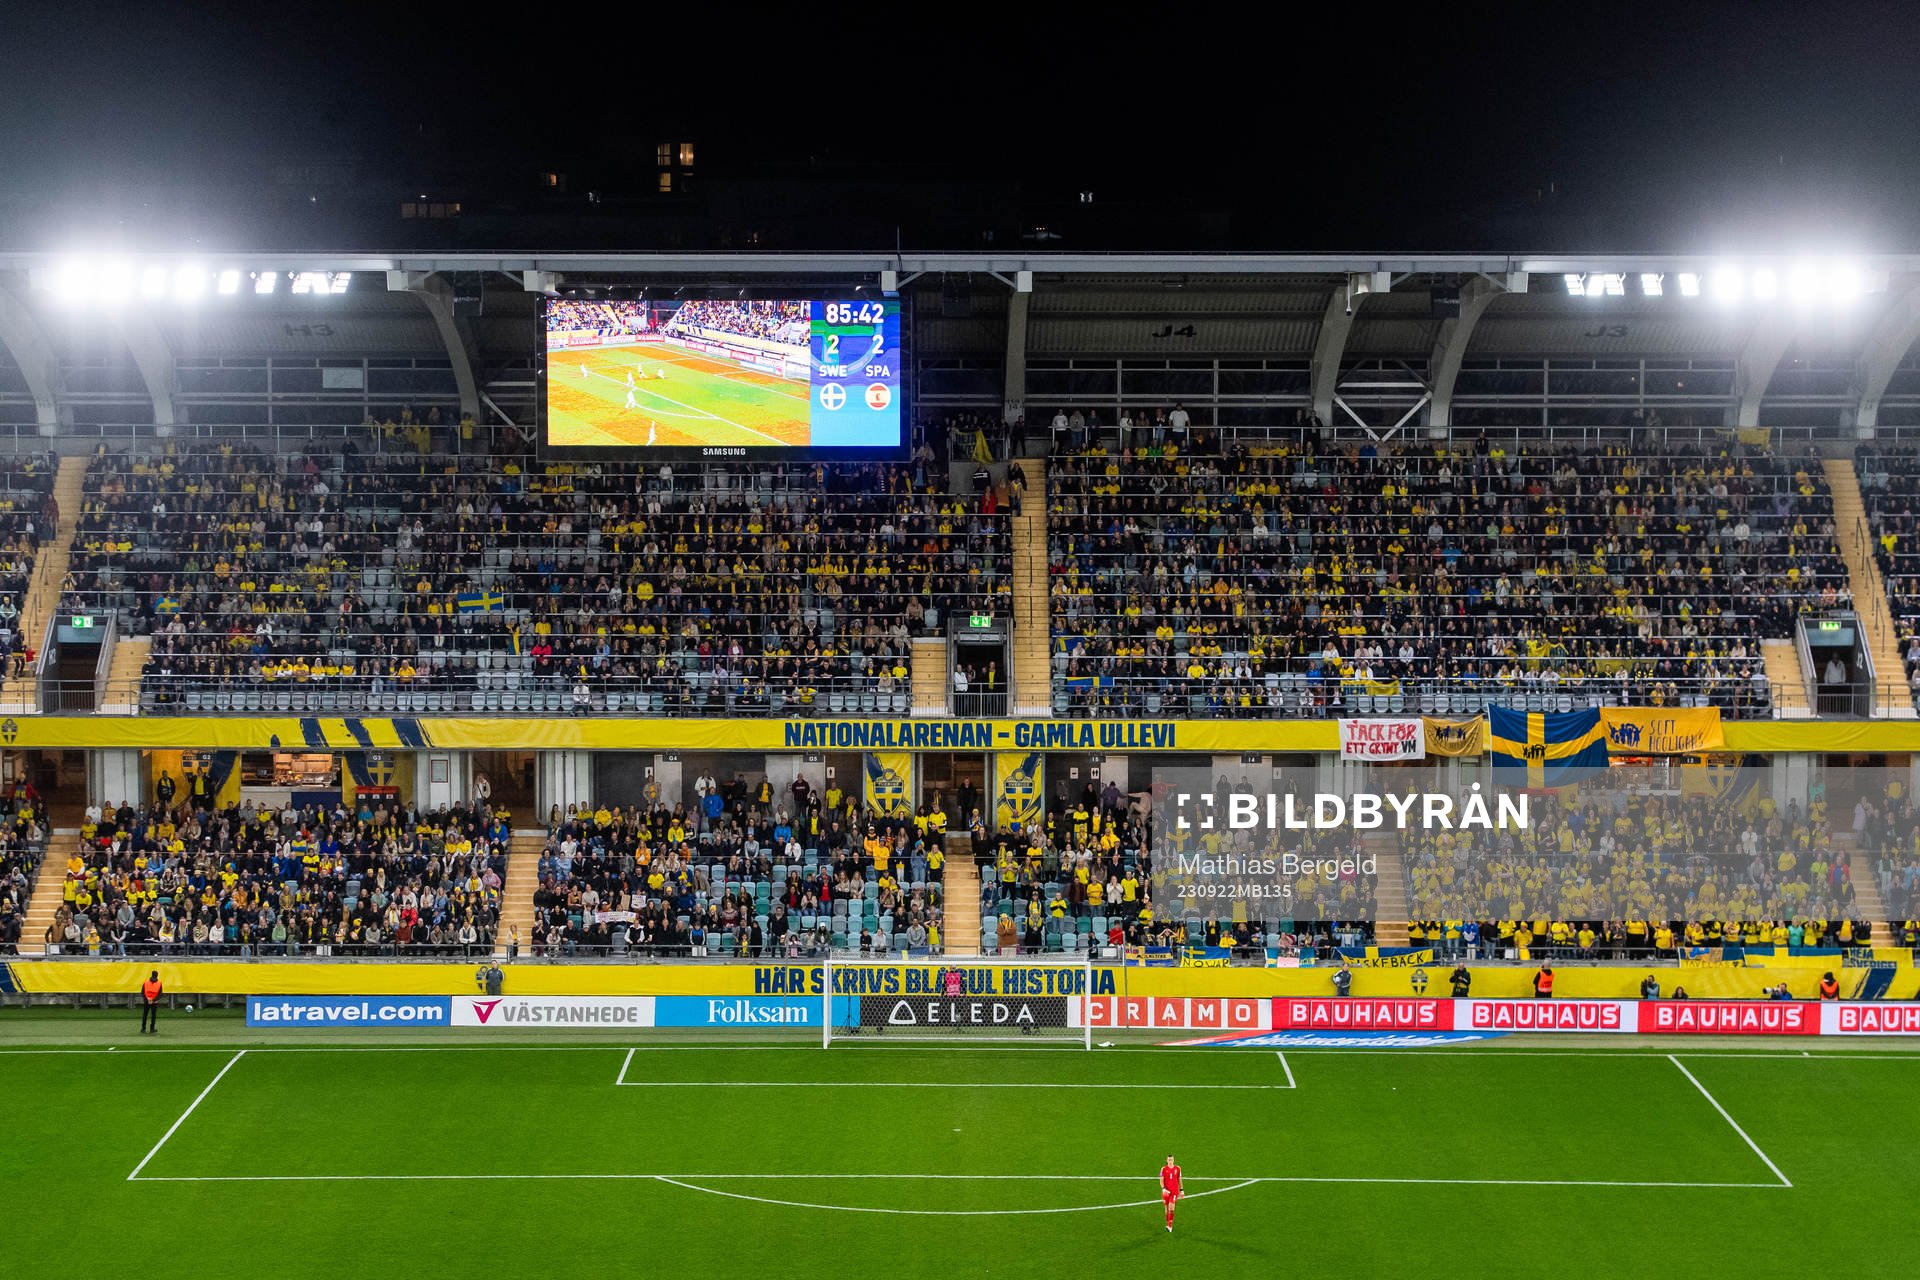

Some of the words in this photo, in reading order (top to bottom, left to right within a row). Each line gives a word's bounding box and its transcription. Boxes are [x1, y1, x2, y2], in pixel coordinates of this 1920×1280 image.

[826, 303, 884, 324] 85:42
[283, 323, 335, 337] H3
[1151, 323, 1197, 338] J4
[1584, 325, 1628, 338] J3
[827, 334, 839, 354] 2
[872, 334, 884, 354] 2
[819, 365, 848, 377] SWE
[865, 365, 891, 377] SPA
[702, 447, 746, 456] SAMSUNG
[785, 722, 992, 747] NATIONALARENAN
[1014, 722, 1094, 748] GAMLA
[1099, 722, 1175, 748] ULLEVI
[1388, 722, 1417, 741] FÖR
[1345, 742, 1366, 754] ETT
[1401, 740, 1417, 753] VM
[754, 966, 805, 993] HÄR
[811, 967, 899, 994] SKRIVS
[1003, 968, 1116, 995] HISTORIA
[253, 1002, 443, 1022] latravel.com
[503, 1000, 638, 1024] VÄSTANHEDE
[707, 999, 809, 1023] Folksam
[1090, 1002, 1252, 1022] CRAMO
[1292, 1002, 1435, 1023] BAUHAUS
[1475, 1004, 1619, 1025] BAUHAUS
[1658, 1005, 1801, 1027] BAUHAUS
